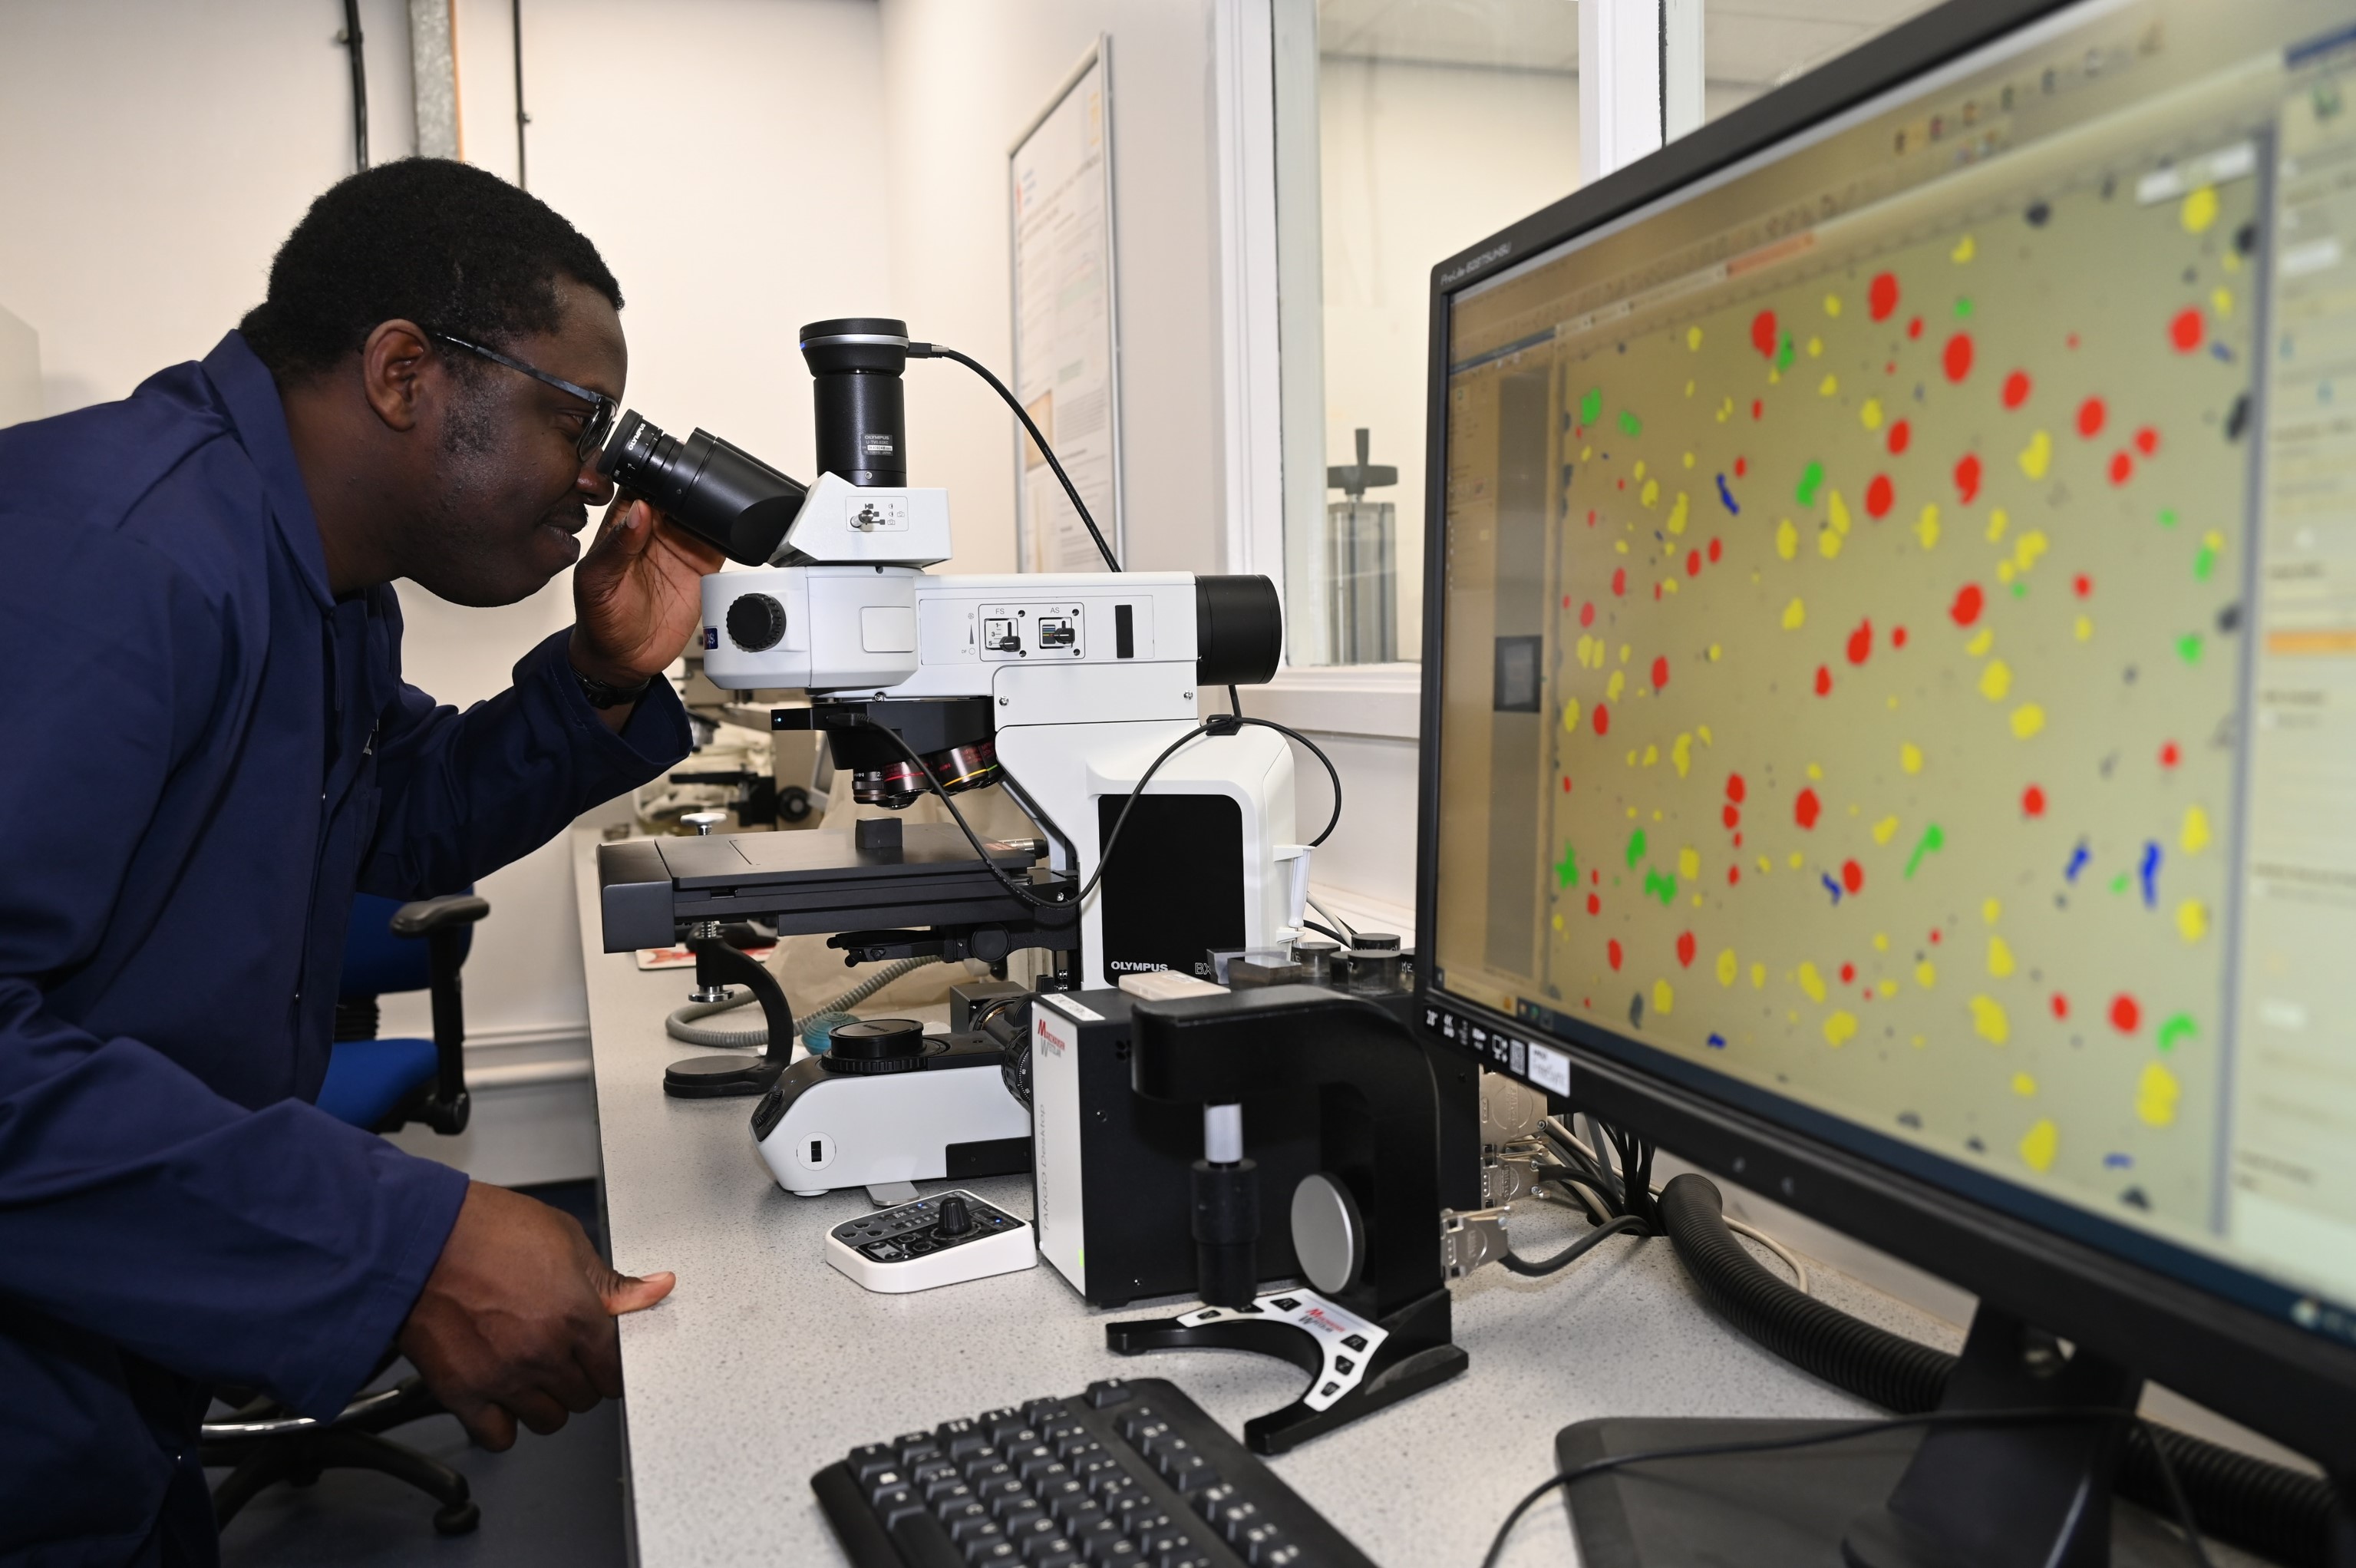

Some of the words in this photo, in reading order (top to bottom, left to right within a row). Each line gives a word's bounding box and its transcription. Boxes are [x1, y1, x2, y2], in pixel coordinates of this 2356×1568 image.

[628, 423, 646, 451] OLYMPUS
[1110, 961, 1169, 972] OLYMPUS
[1041, 1172, 1050, 1231] TANGO
